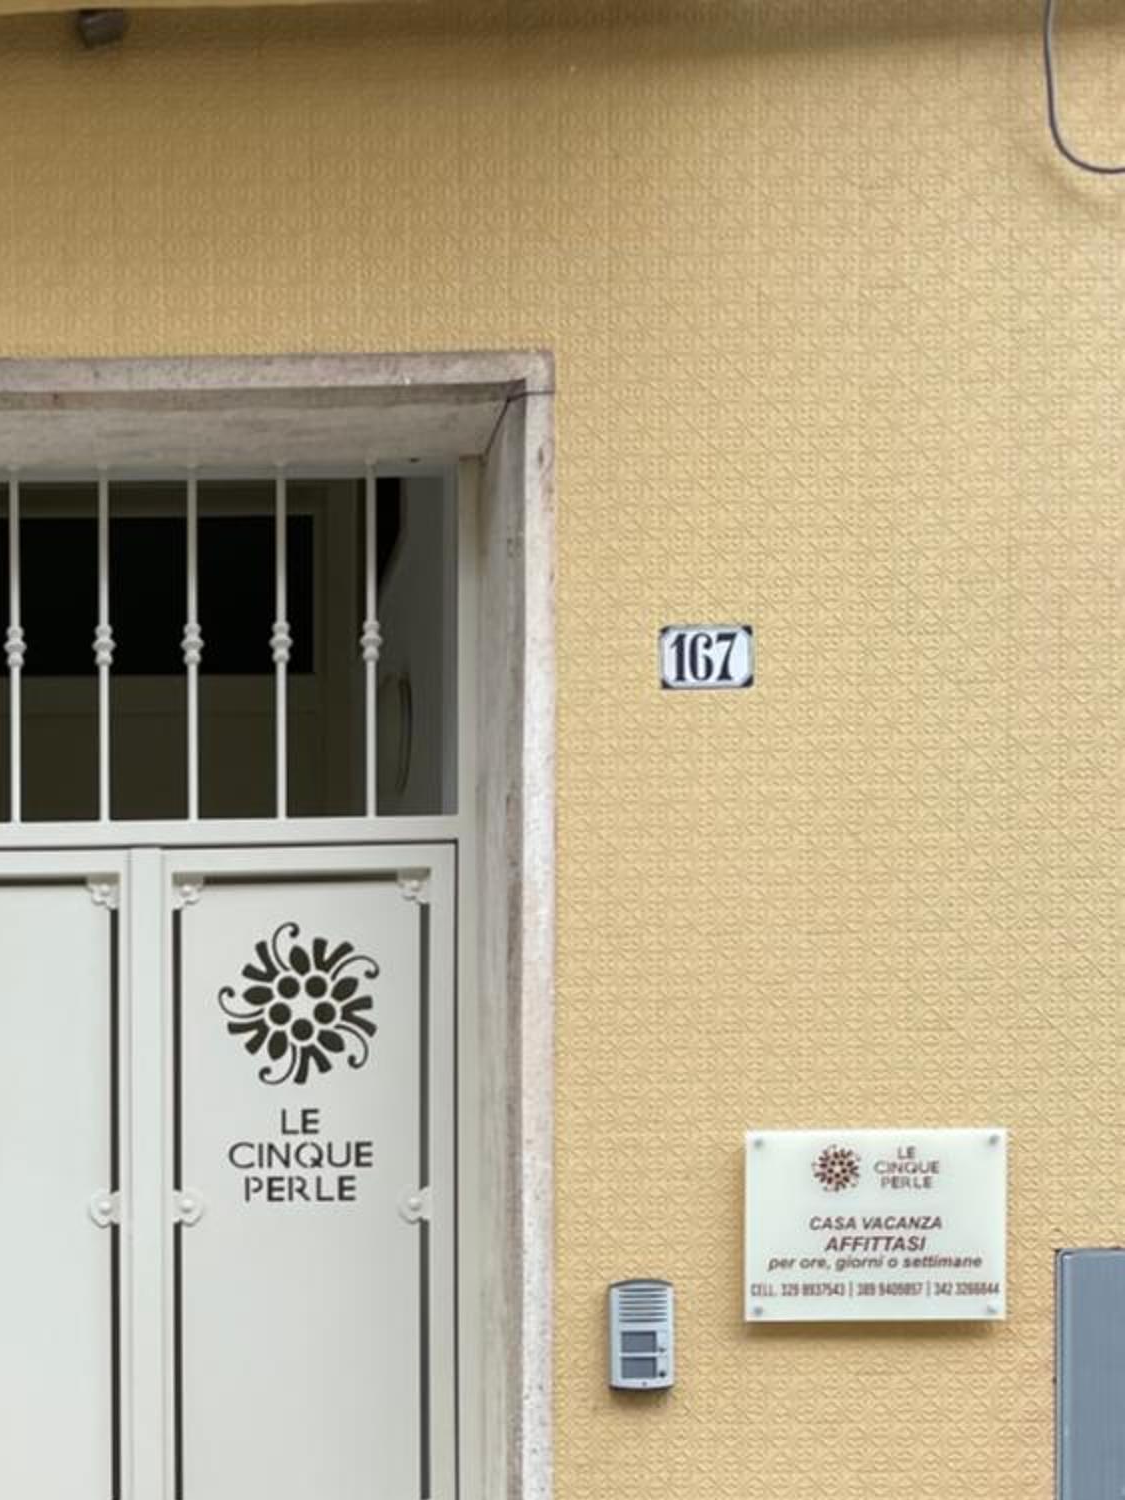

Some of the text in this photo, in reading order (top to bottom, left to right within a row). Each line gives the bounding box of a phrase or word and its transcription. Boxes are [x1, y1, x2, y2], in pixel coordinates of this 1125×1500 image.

[670, 632, 737, 681] 167
[280, 1108, 320, 1135] LE
[228, 1141, 374, 1169] CINQUE
[897, 1146, 916, 1159] LE
[873, 1160, 939, 1174] CINQUE
[244, 1175, 357, 1203] PERLE
[880, 1175, 932, 1189] PERLE
[809, 1215, 943, 1230] CASA VACANZA
[824, 1236, 927, 1251] AFFITTASI
[767, 1254, 983, 1272] per ore, giorni o settimane
